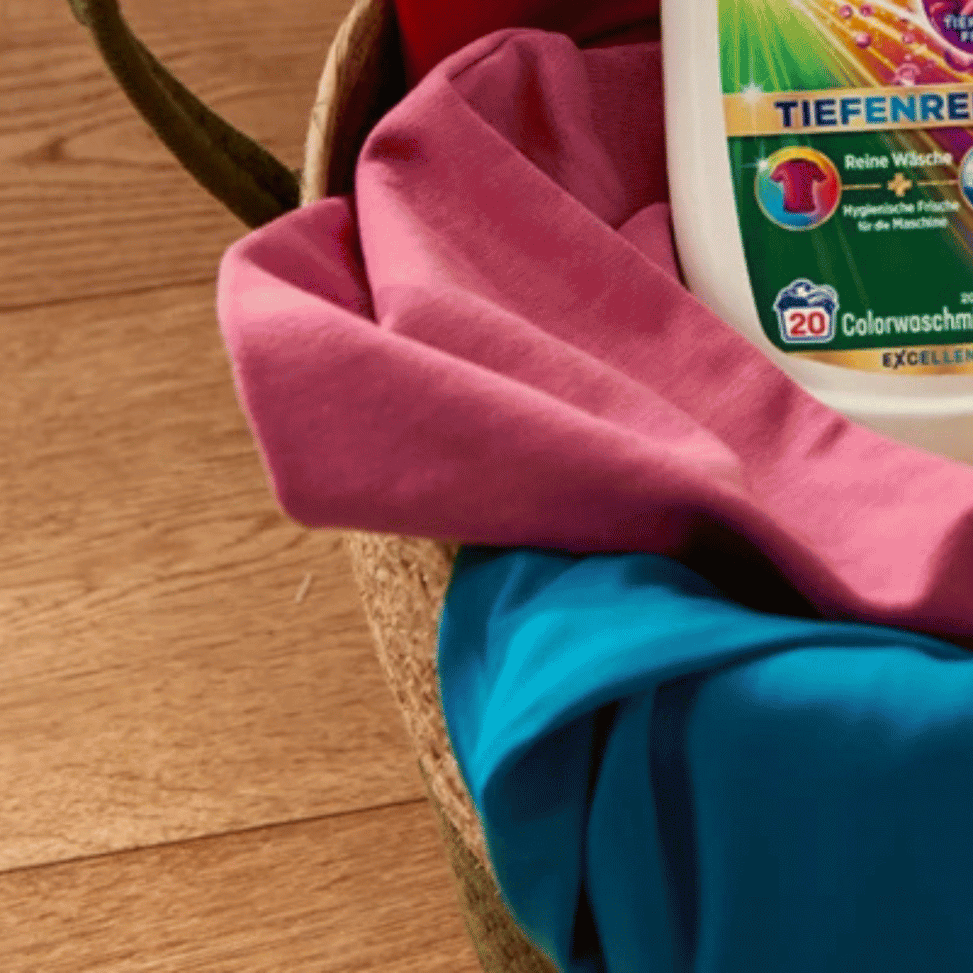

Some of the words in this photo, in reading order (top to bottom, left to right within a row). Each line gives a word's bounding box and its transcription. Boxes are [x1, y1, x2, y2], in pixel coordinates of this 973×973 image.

[844, 153, 889, 169] Reine
[891, 150, 953, 167] Wäsche
[788, 311, 828, 337] 20
